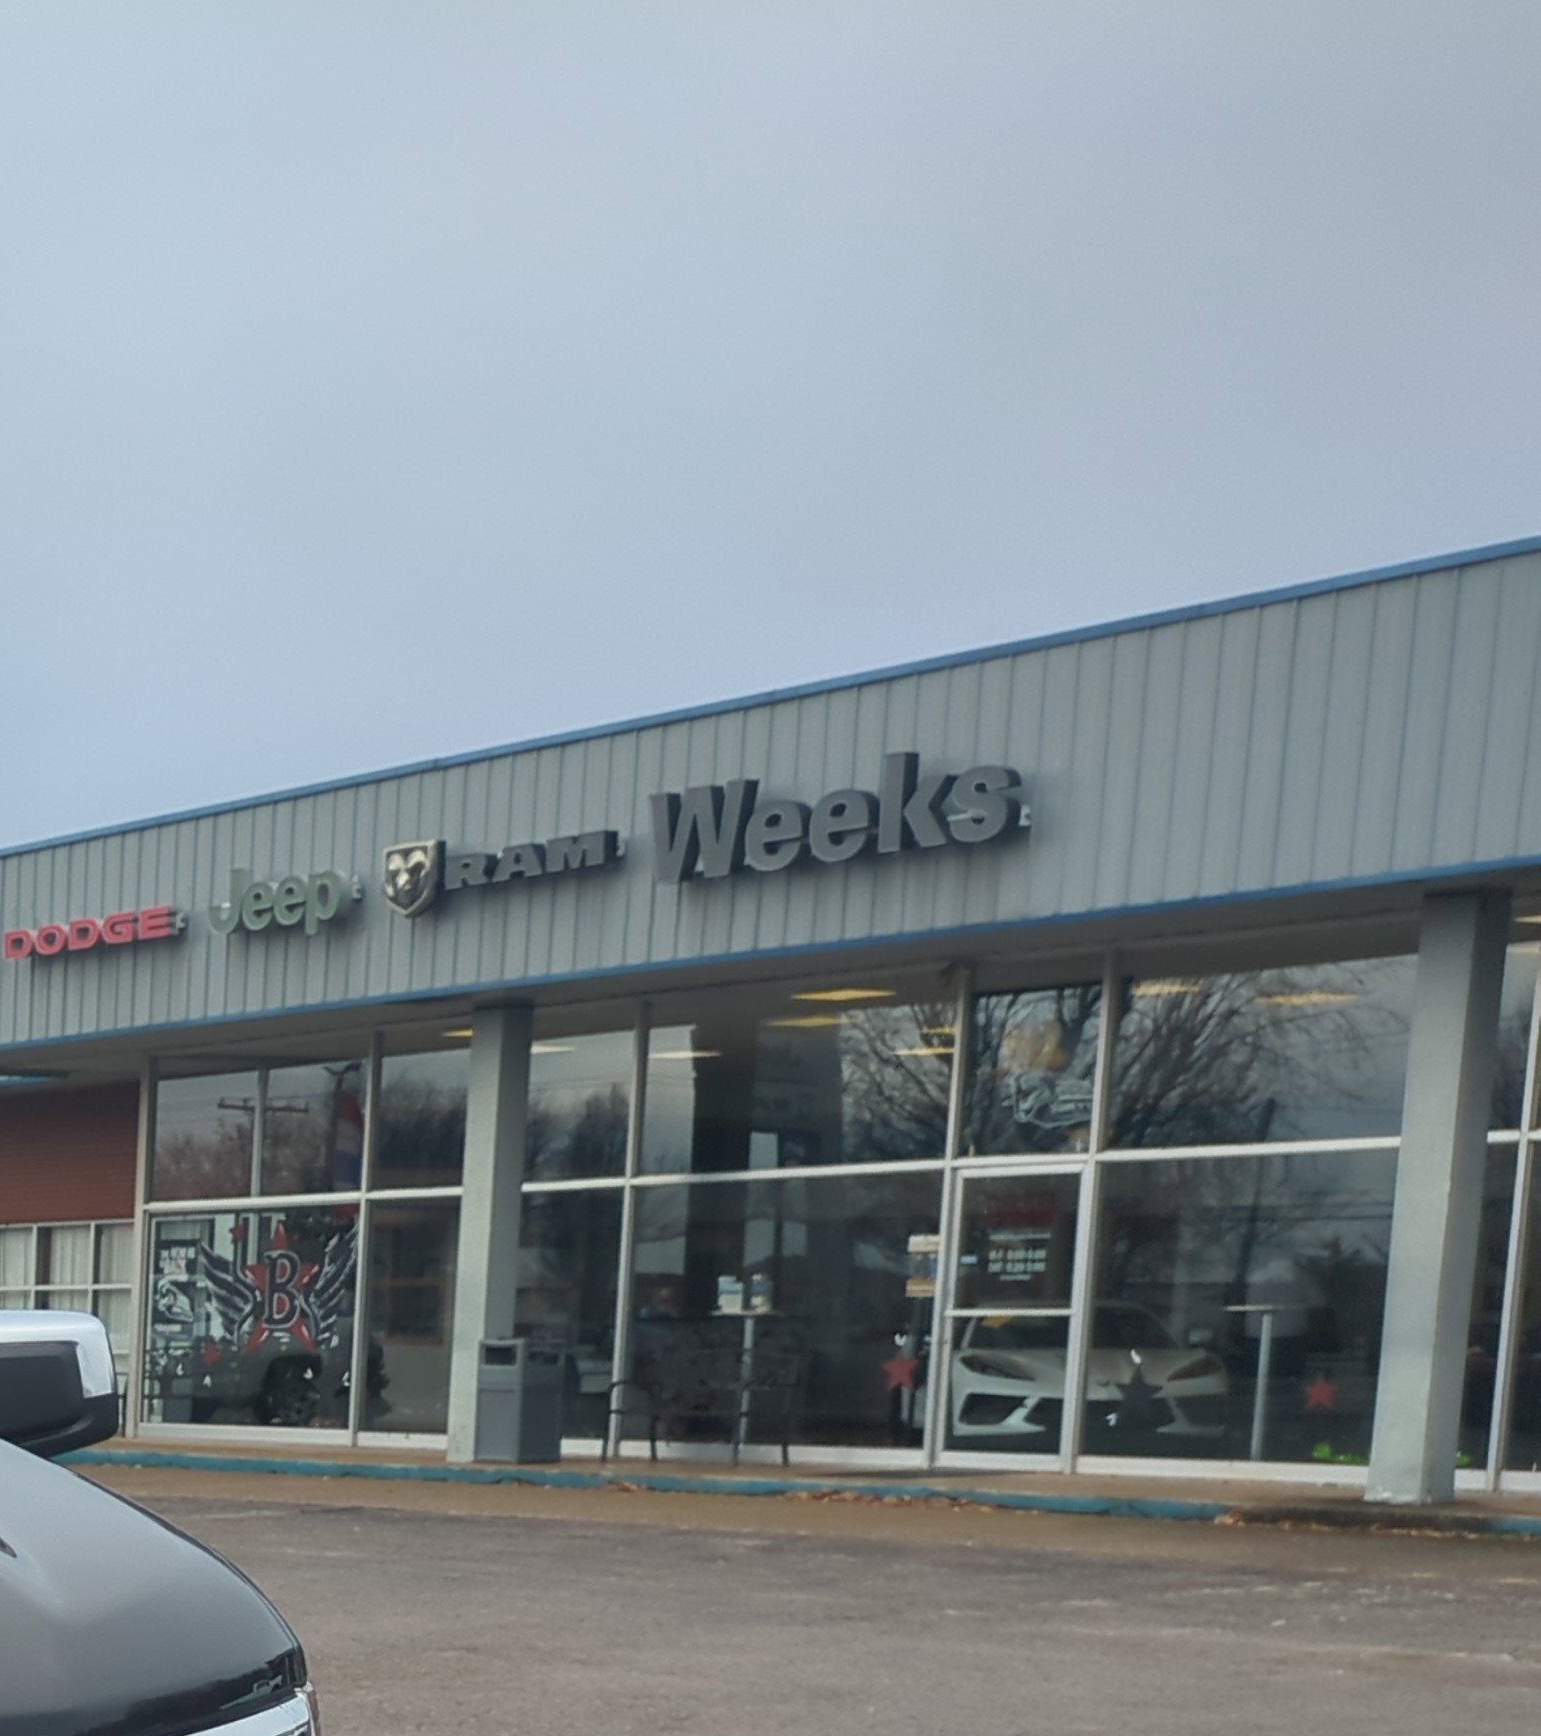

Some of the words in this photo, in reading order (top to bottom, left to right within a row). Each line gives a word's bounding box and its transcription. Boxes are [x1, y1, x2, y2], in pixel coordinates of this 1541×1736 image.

[650, 752, 1022, 884] Weeks
[445, 830, 617, 890] RAM
[3, 905, 175, 960] DODGE
[210, 869, 341, 934] Jeep
